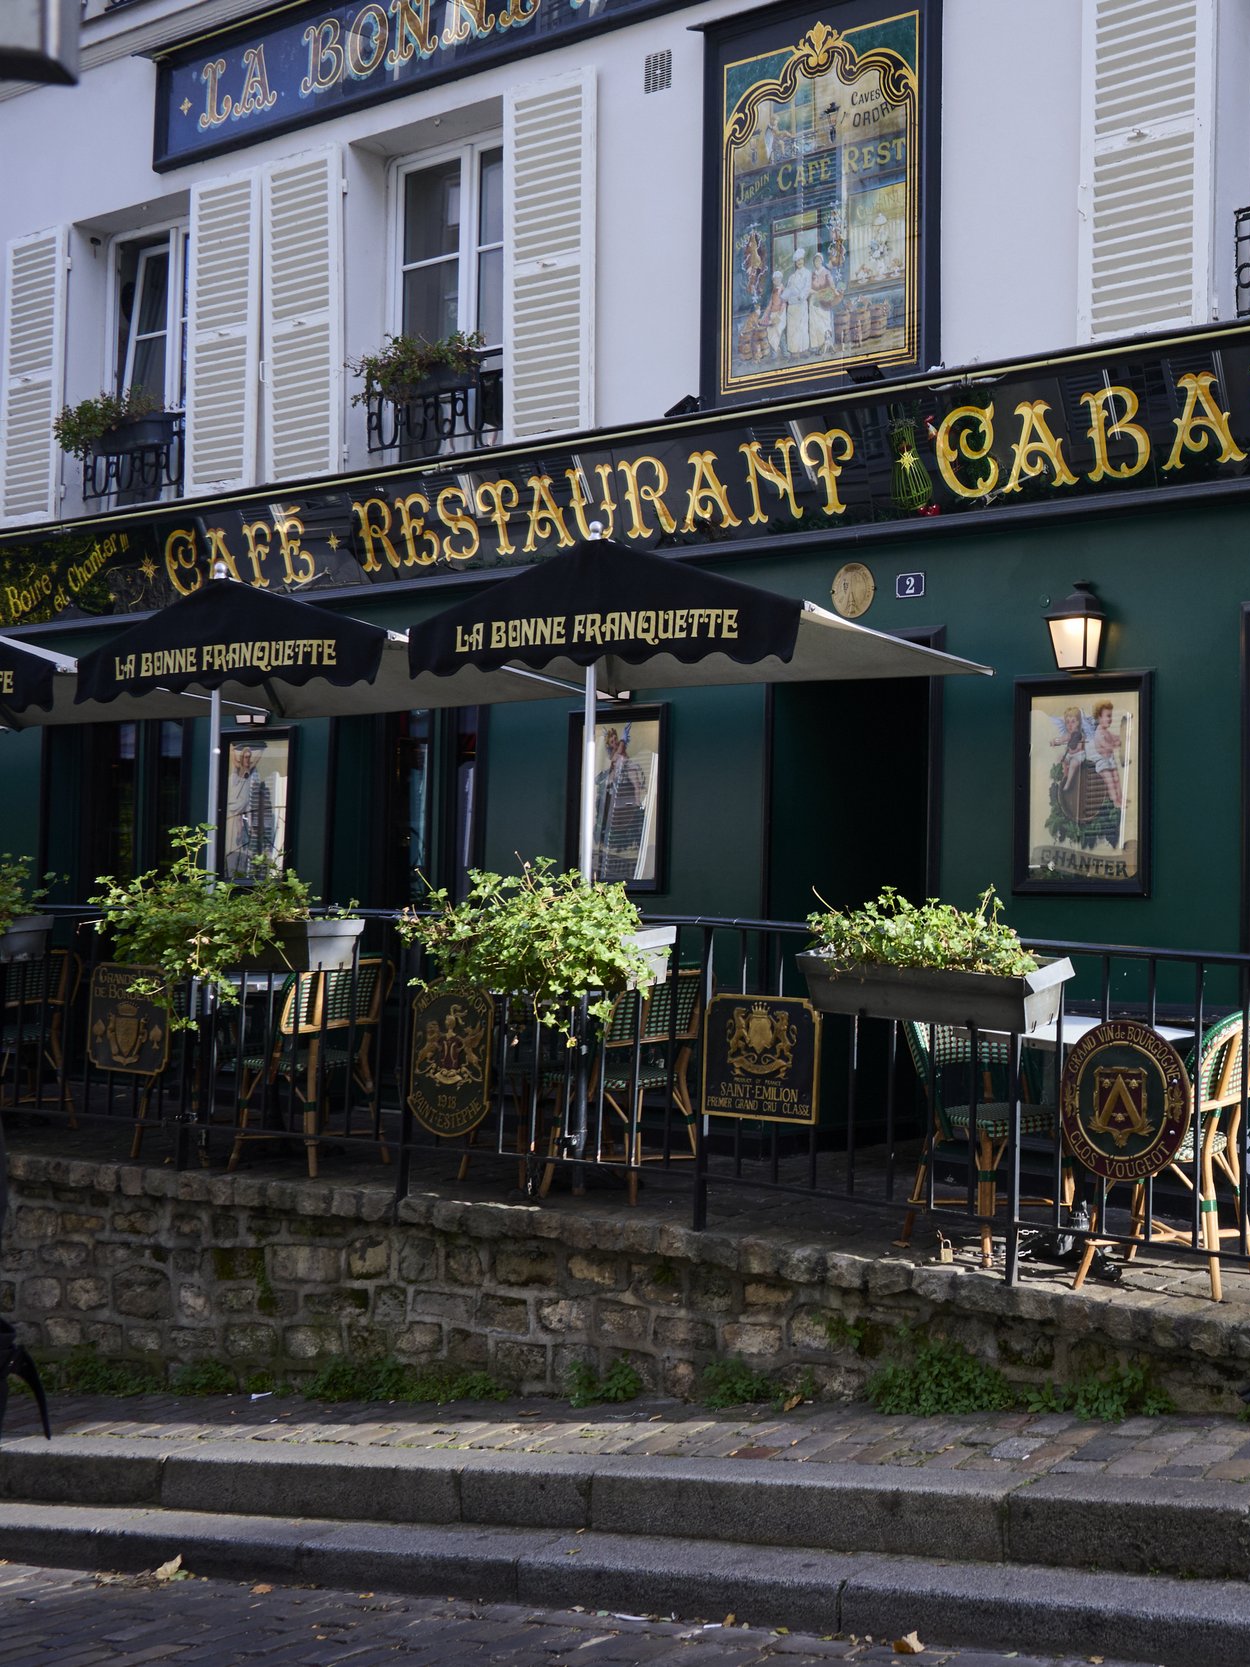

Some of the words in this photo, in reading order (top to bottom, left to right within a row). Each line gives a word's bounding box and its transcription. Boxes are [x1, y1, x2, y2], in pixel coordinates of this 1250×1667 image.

[199, 43, 277, 130] LA
[851, 88, 881, 106] CAVES
[852, 101, 896, 127] ORDR
[844, 137, 906, 175] REST
[164, 506, 316, 597] CAFÉ
[352, 428, 854, 573] RESTAURANT
[5, 573, 52, 618] Boire
[67, 532, 117, 592] Chanter
[905, 576, 915, 594] 2
[455, 624, 483, 652] LA
[490, 615, 566, 649] BONNE
[572, 608, 739, 645] FRANQUETTE
[114, 653, 136, 681] LA
[140, 647, 197, 677] BONNE
[202, 639, 337, 672] FRANQUETTE
[1041, 848, 1129, 878] CHANTER
[94, 986, 107, 998] DE
[99, 967, 137, 984] GRANDS
[1067, 1035, 1097, 1074] GRAND
[1098, 1025, 1115, 1043] VIN
[1114, 1027, 1126, 1040] de
[1127, 1026, 1182, 1083] BOURGOGNE
[707, 1096, 732, 1108] PREMIER
[735, 1098, 758, 1111] GRAND
[762, 1101, 777, 1112] CRU
[1070, 1130, 1099, 1168] CLOS
[1105, 1141, 1172, 1178] VOUGEOT
